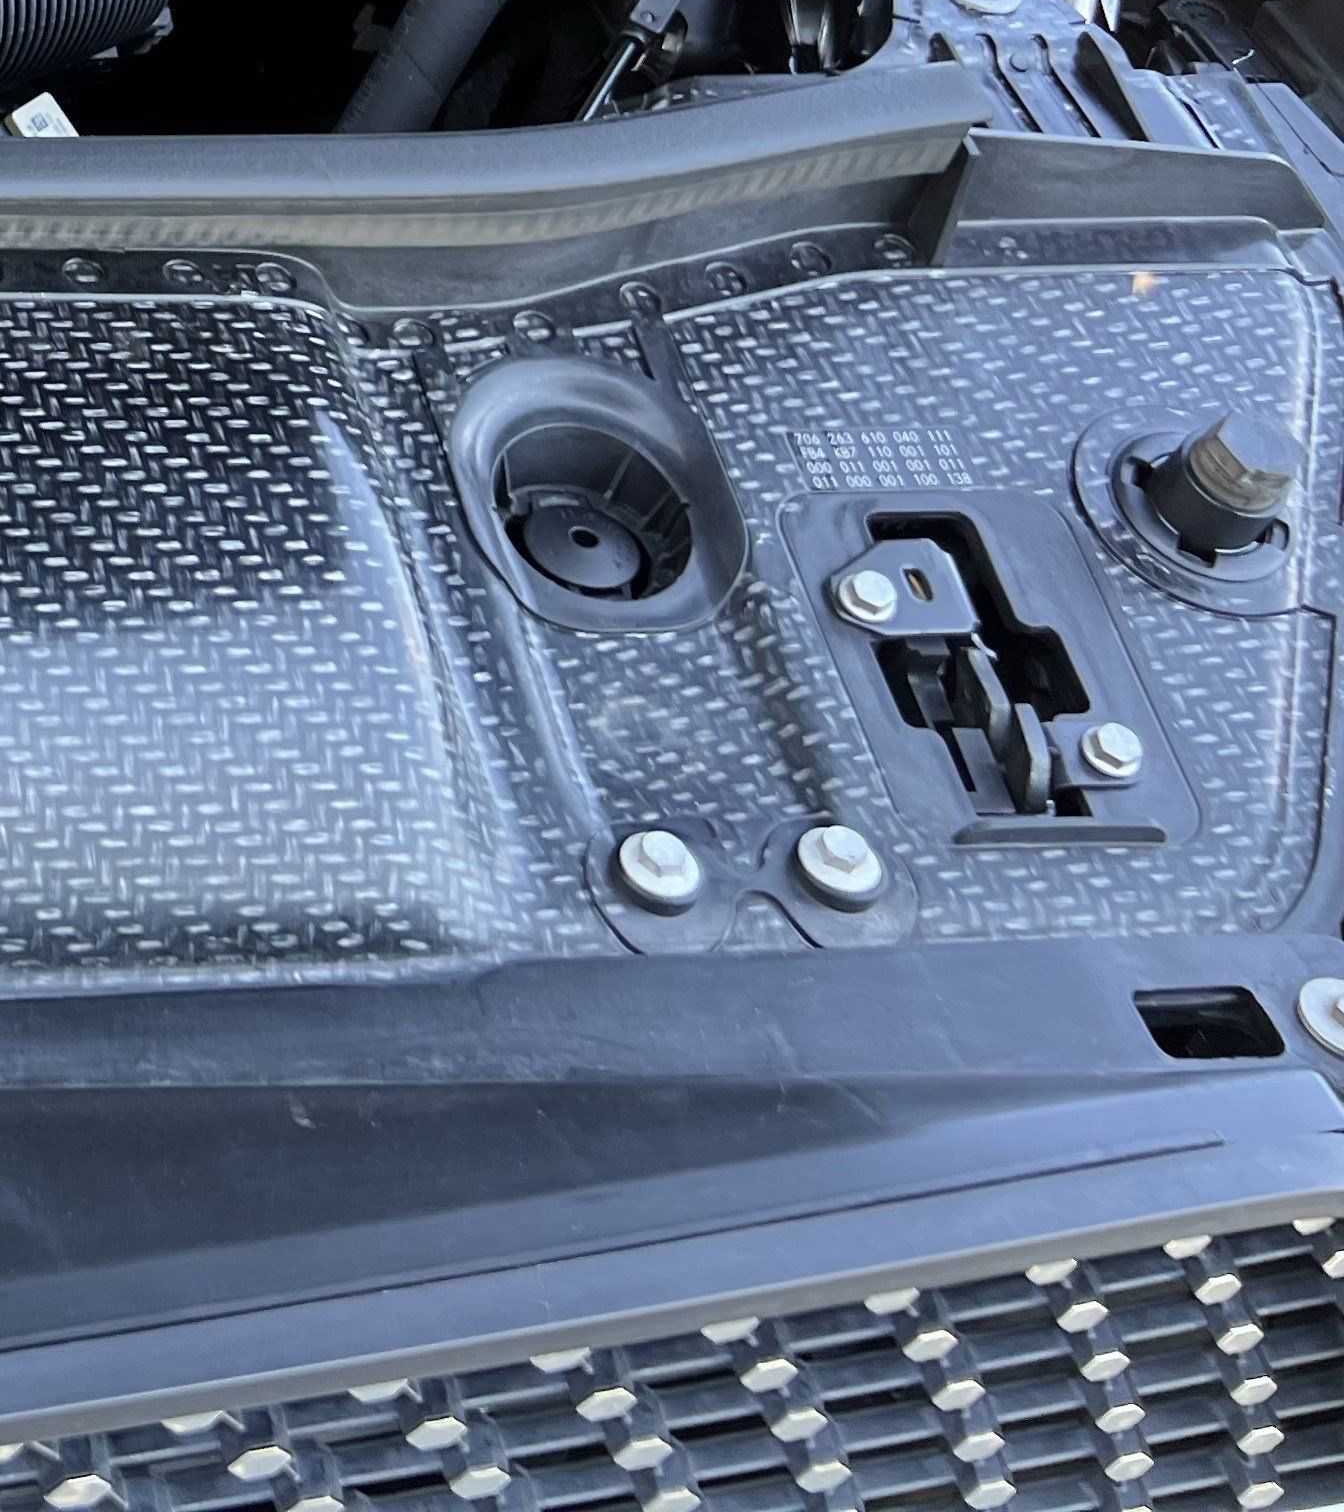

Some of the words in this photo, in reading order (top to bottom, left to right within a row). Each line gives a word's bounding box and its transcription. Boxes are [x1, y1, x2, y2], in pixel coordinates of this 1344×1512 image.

[927, 429, 952, 442] 111
[868, 445, 892, 458] 110
[899, 444, 926, 458] 001
[933, 443, 958, 457] 101
[806, 461, 832, 474] 000
[839, 460, 866, 474] 011
[872, 460, 899, 473] 001
[905, 459, 932, 472] 001
[938, 458, 965, 471] 011
[813, 475, 839, 489] 011
[845, 474, 872, 488] 000
[878, 474, 905, 487] 001
[913, 473, 939, 486] 100
